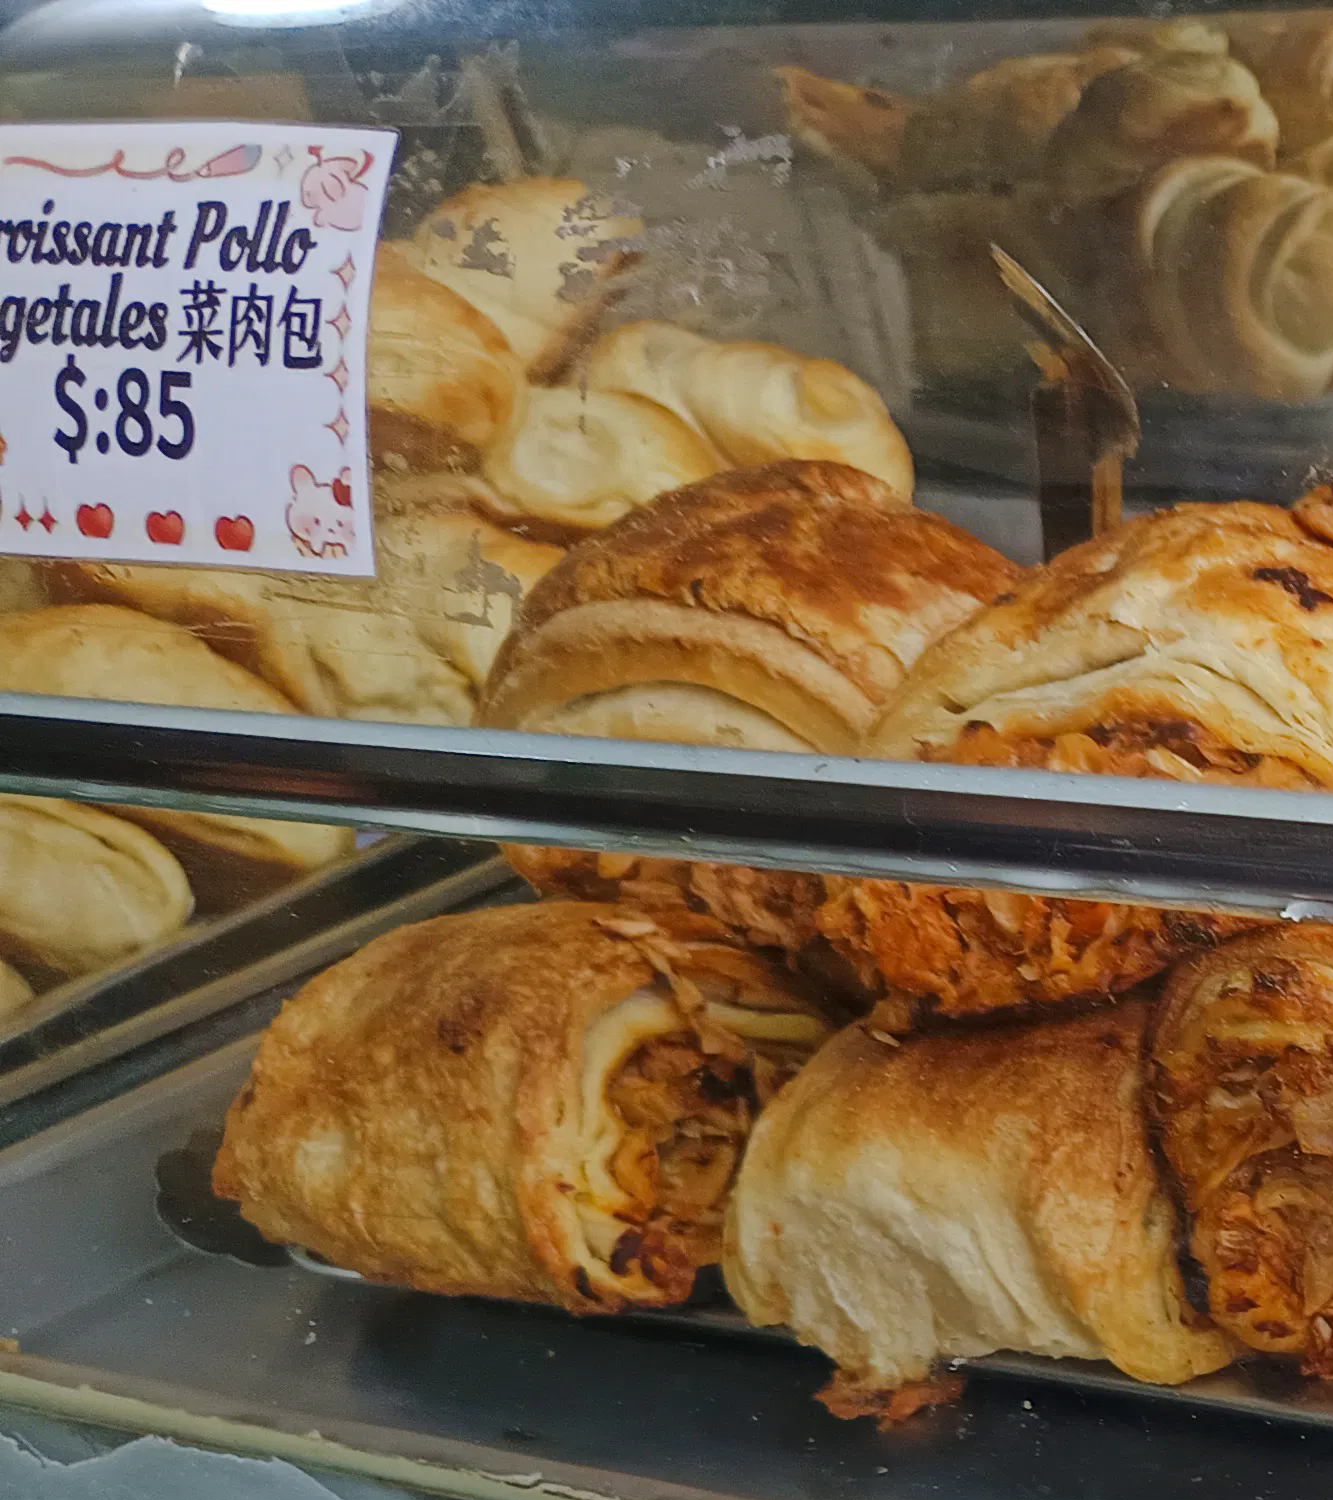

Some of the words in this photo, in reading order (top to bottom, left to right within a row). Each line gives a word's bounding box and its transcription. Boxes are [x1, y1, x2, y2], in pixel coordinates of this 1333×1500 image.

[183, 199, 317, 274] Pollo
[176, 279, 324, 370] 菜肉包
[53, 353, 196, 464] $:85
